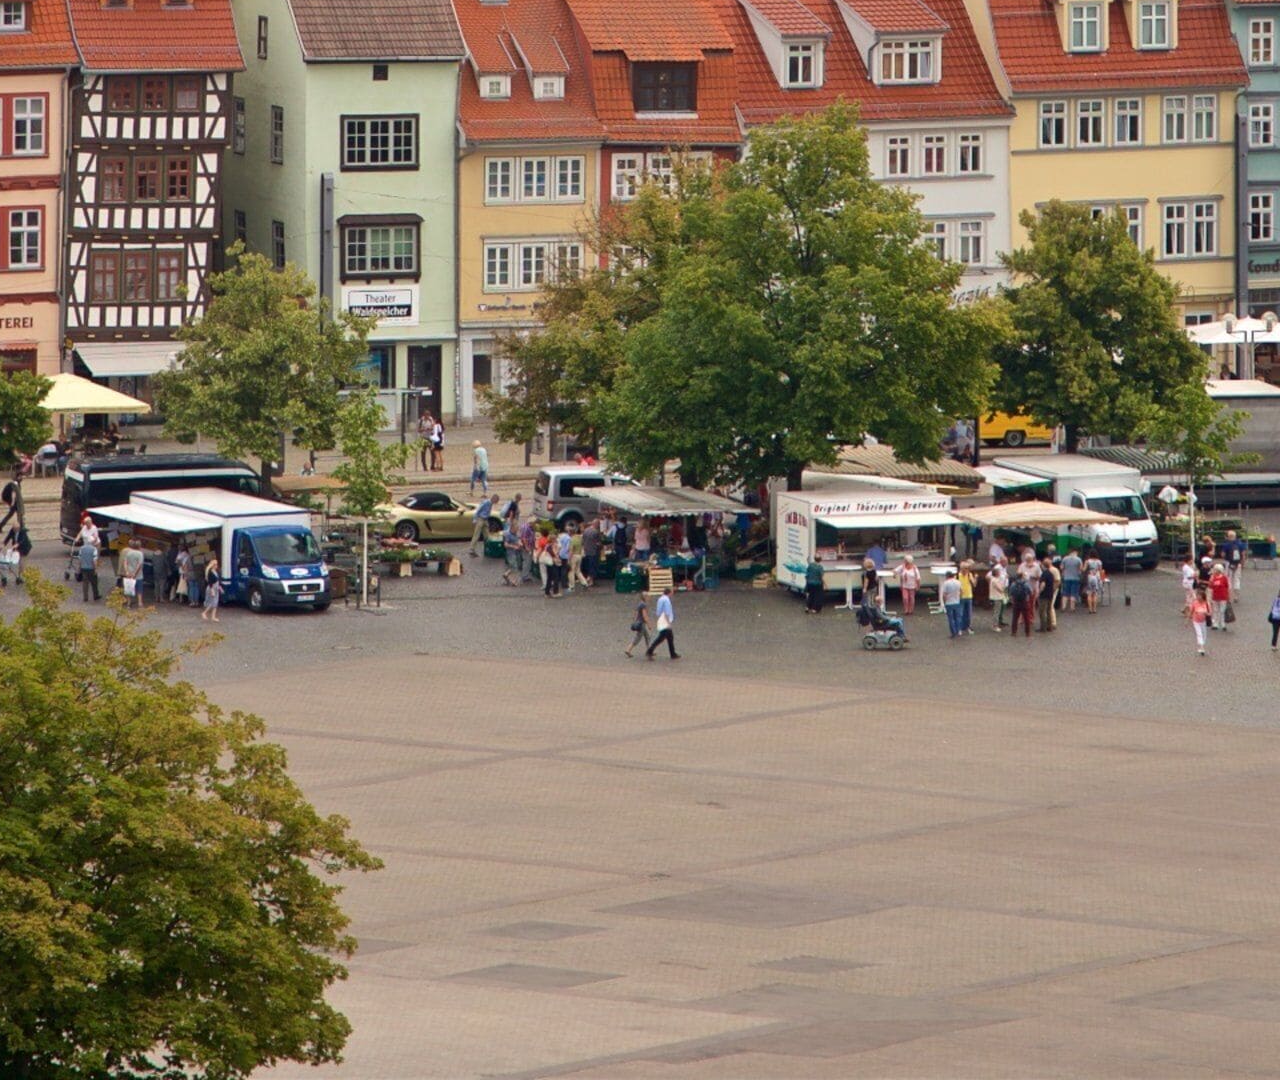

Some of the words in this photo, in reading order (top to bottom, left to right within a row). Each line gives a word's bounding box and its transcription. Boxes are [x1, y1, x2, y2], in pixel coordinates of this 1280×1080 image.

[365, 294, 396, 303] Theater
[814, 503, 851, 515] Original
[856, 501, 898, 514] Thüringer
[903, 501, 947, 511] Bratwurst
